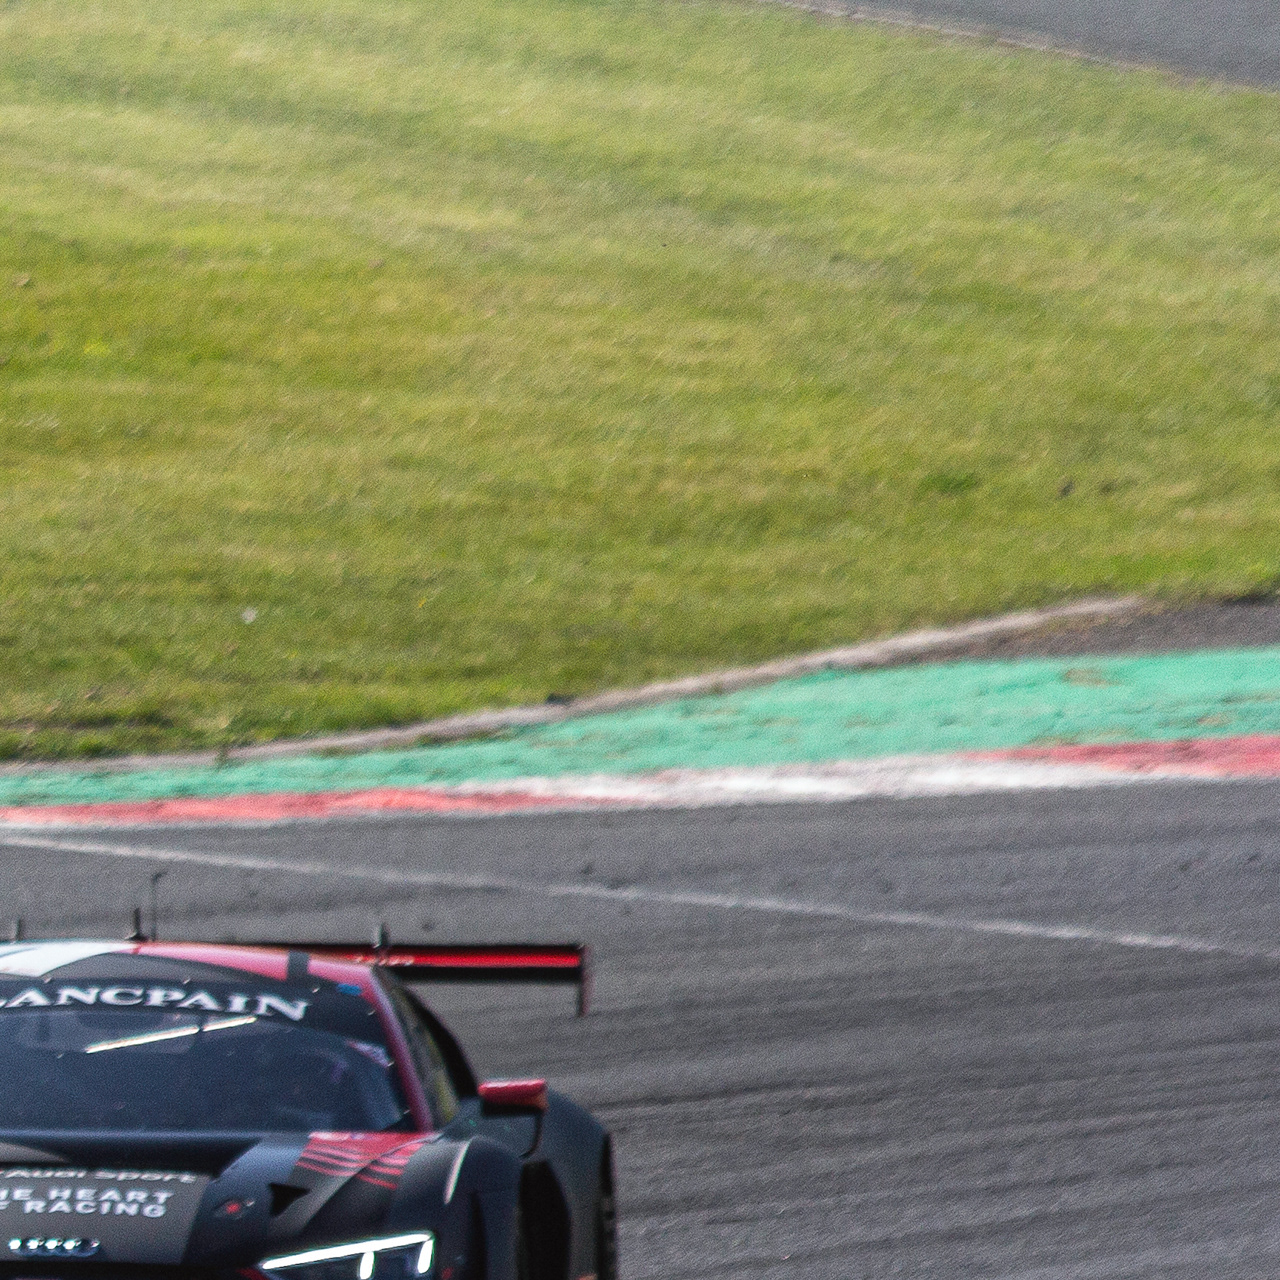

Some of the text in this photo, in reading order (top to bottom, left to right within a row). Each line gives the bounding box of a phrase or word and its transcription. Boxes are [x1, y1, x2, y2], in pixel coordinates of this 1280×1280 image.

[94, 1170, 197, 1184] Sport
[47, 1188, 174, 1204] HEART
[23, 1201, 167, 1218] RACING
